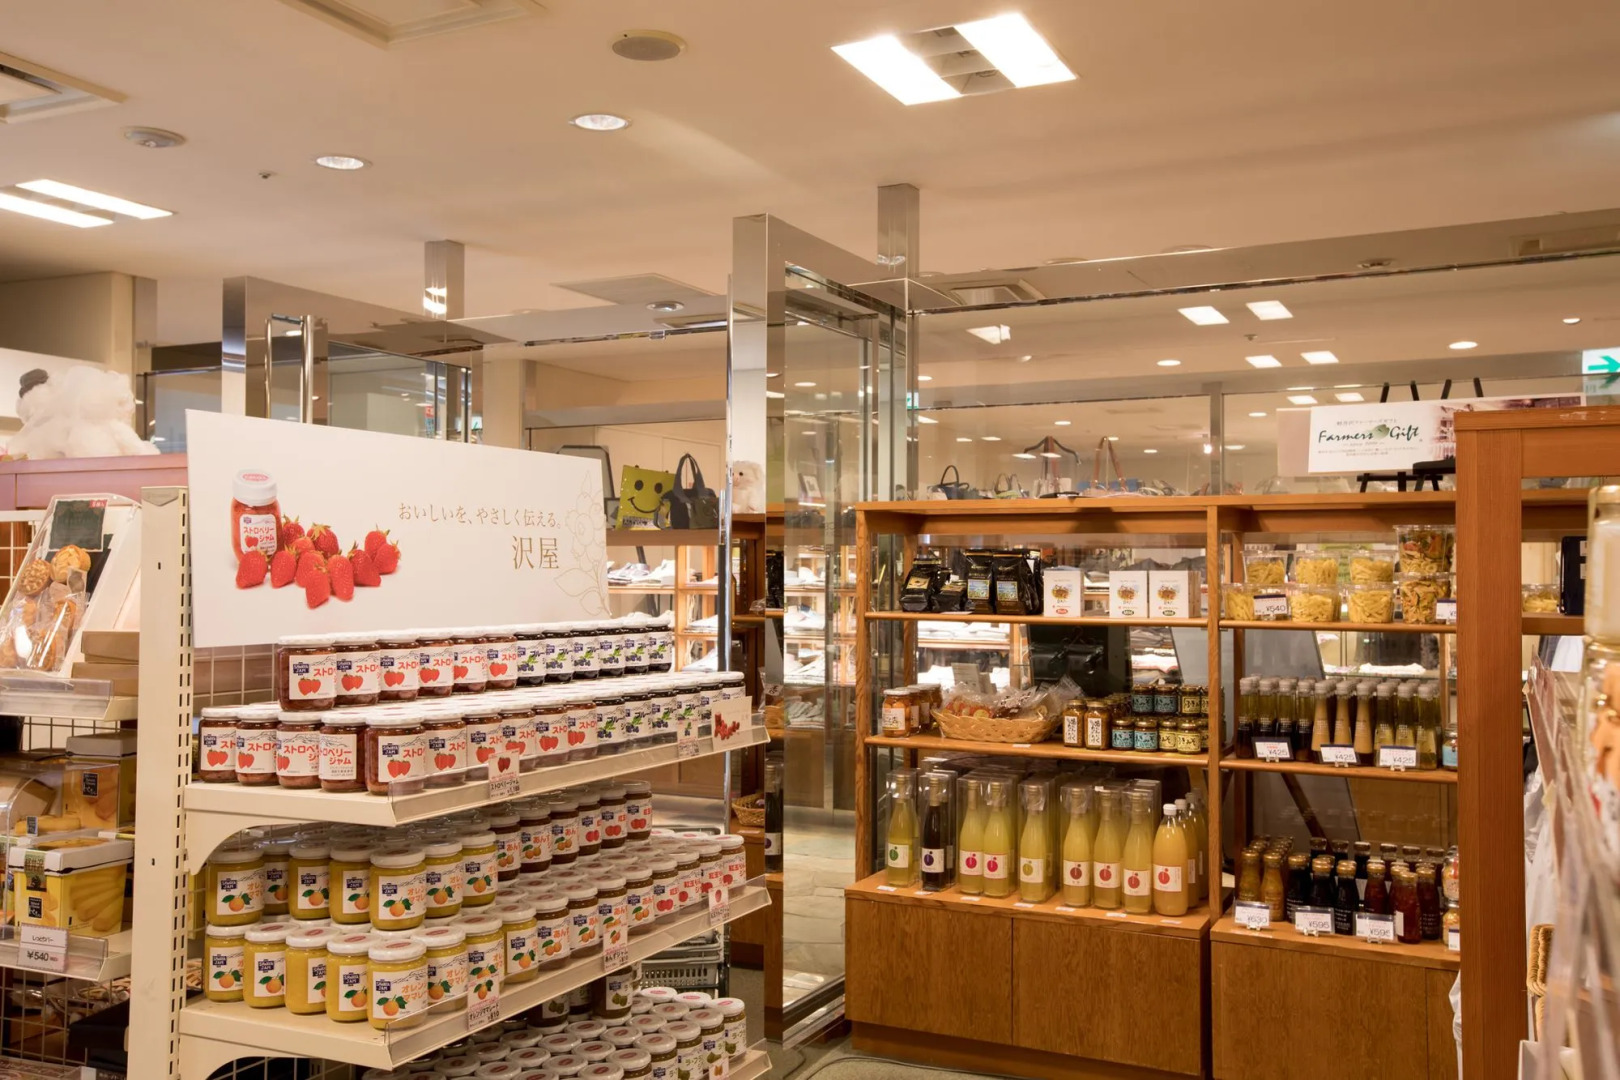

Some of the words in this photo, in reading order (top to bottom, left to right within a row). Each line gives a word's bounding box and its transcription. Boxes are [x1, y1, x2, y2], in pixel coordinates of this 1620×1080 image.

[1318, 430, 1374, 443] Farmers
[1389, 424, 1419, 441] Gift
[399, 503, 561, 529] おいしいを、やさしく伝える。
[512, 535, 560, 570] 沢屋
[1266, 604, 1286, 613] ¥540
[398, 661, 419, 669] ストロ
[519, 730, 537, 739] ストロ
[403, 748, 425, 758] ストロ
[329, 757, 351, 765] ジャム
[1308, 921, 1329, 929] ¥595
[27, 950, 49, 962] ¥540
